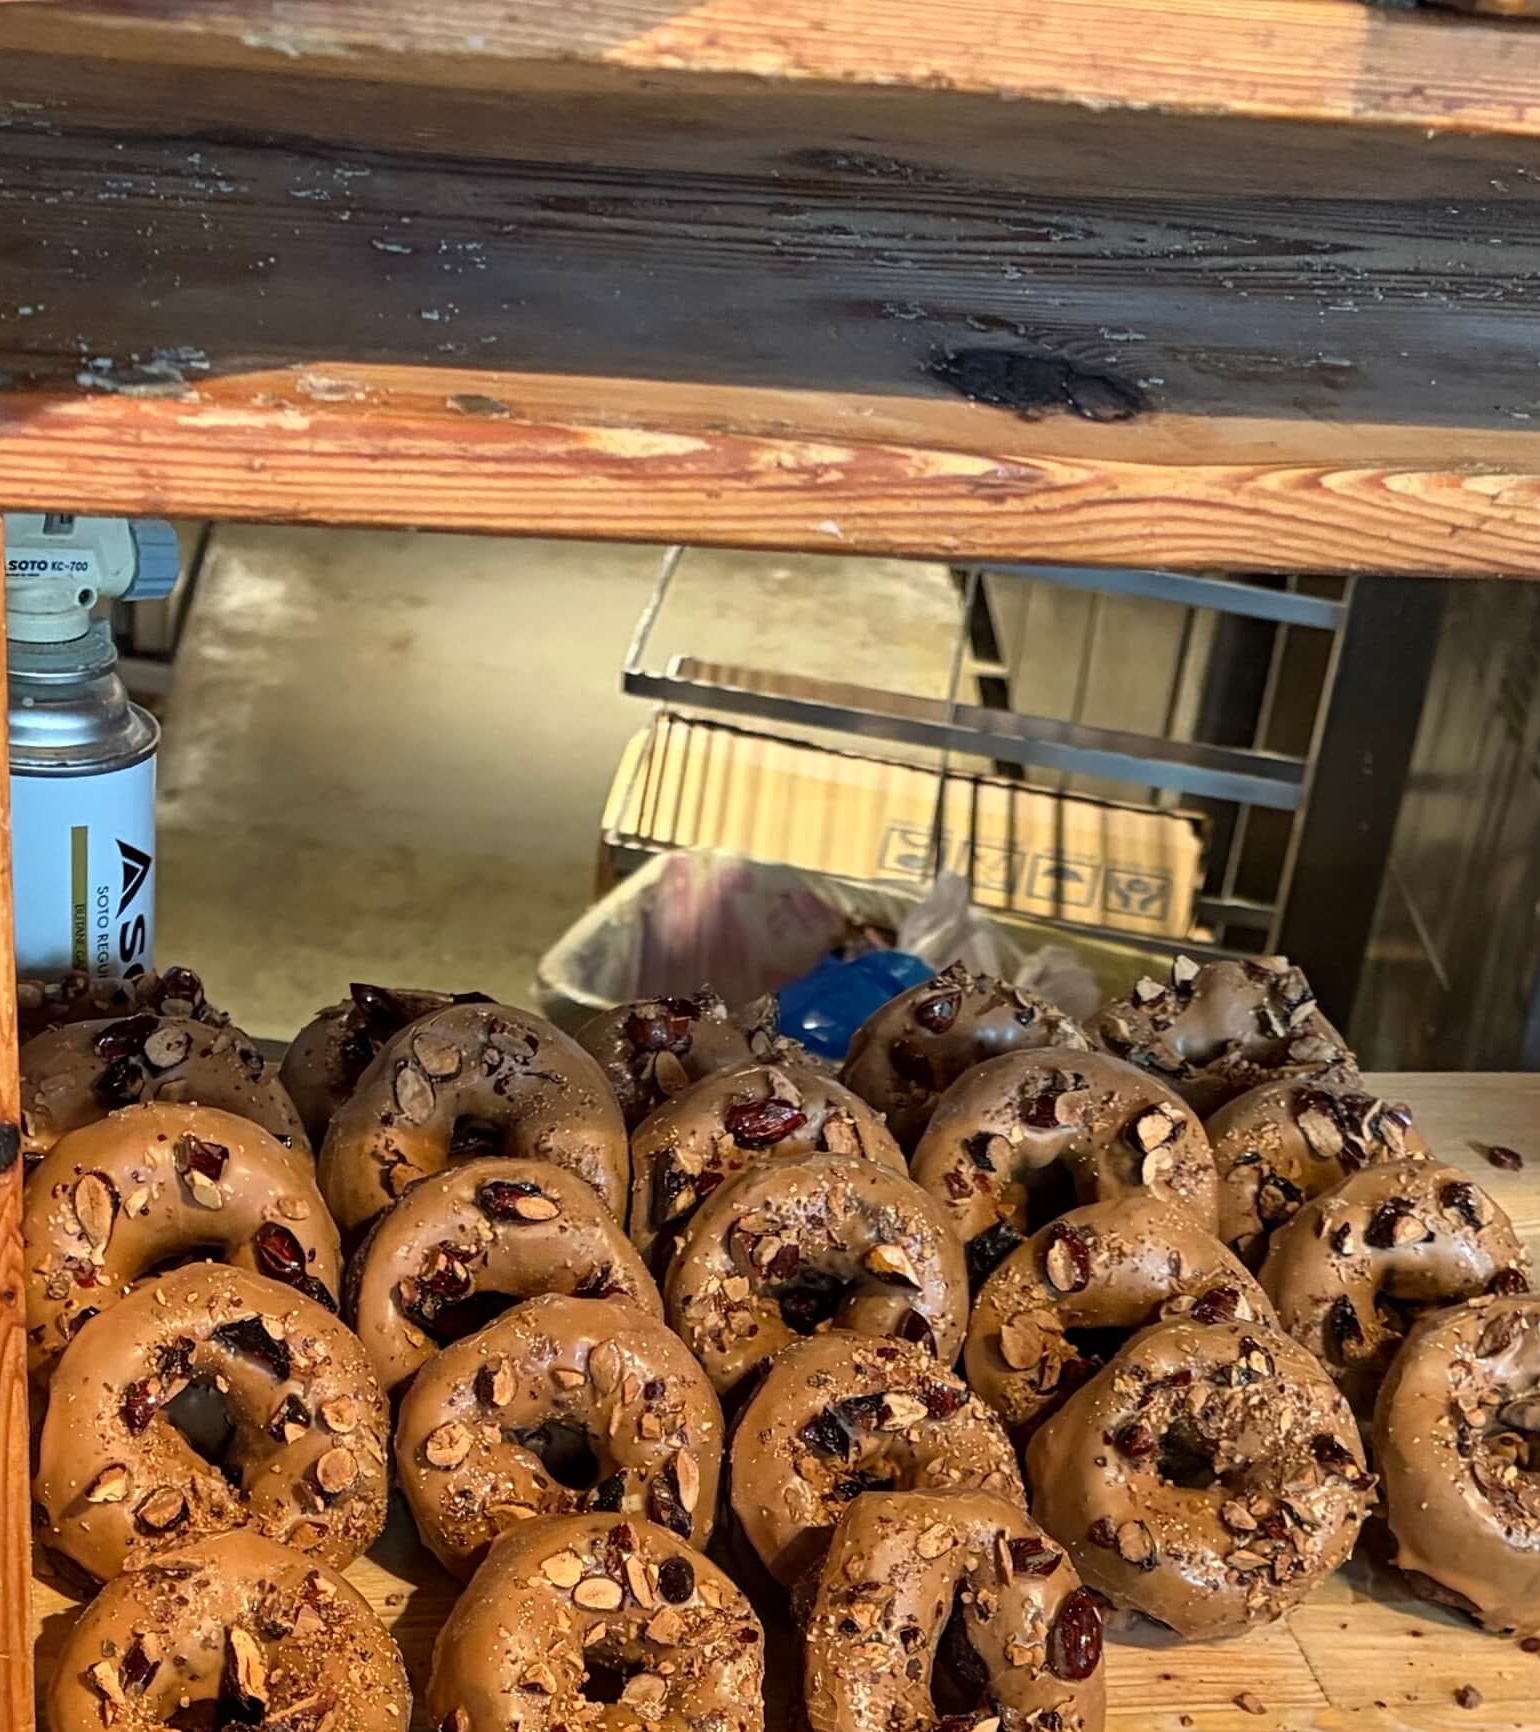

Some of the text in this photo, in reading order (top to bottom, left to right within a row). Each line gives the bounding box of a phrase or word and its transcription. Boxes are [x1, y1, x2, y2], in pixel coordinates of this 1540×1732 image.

[8, 559, 89, 572] SOTO KC-700
[96, 885, 110, 929] SOTO
